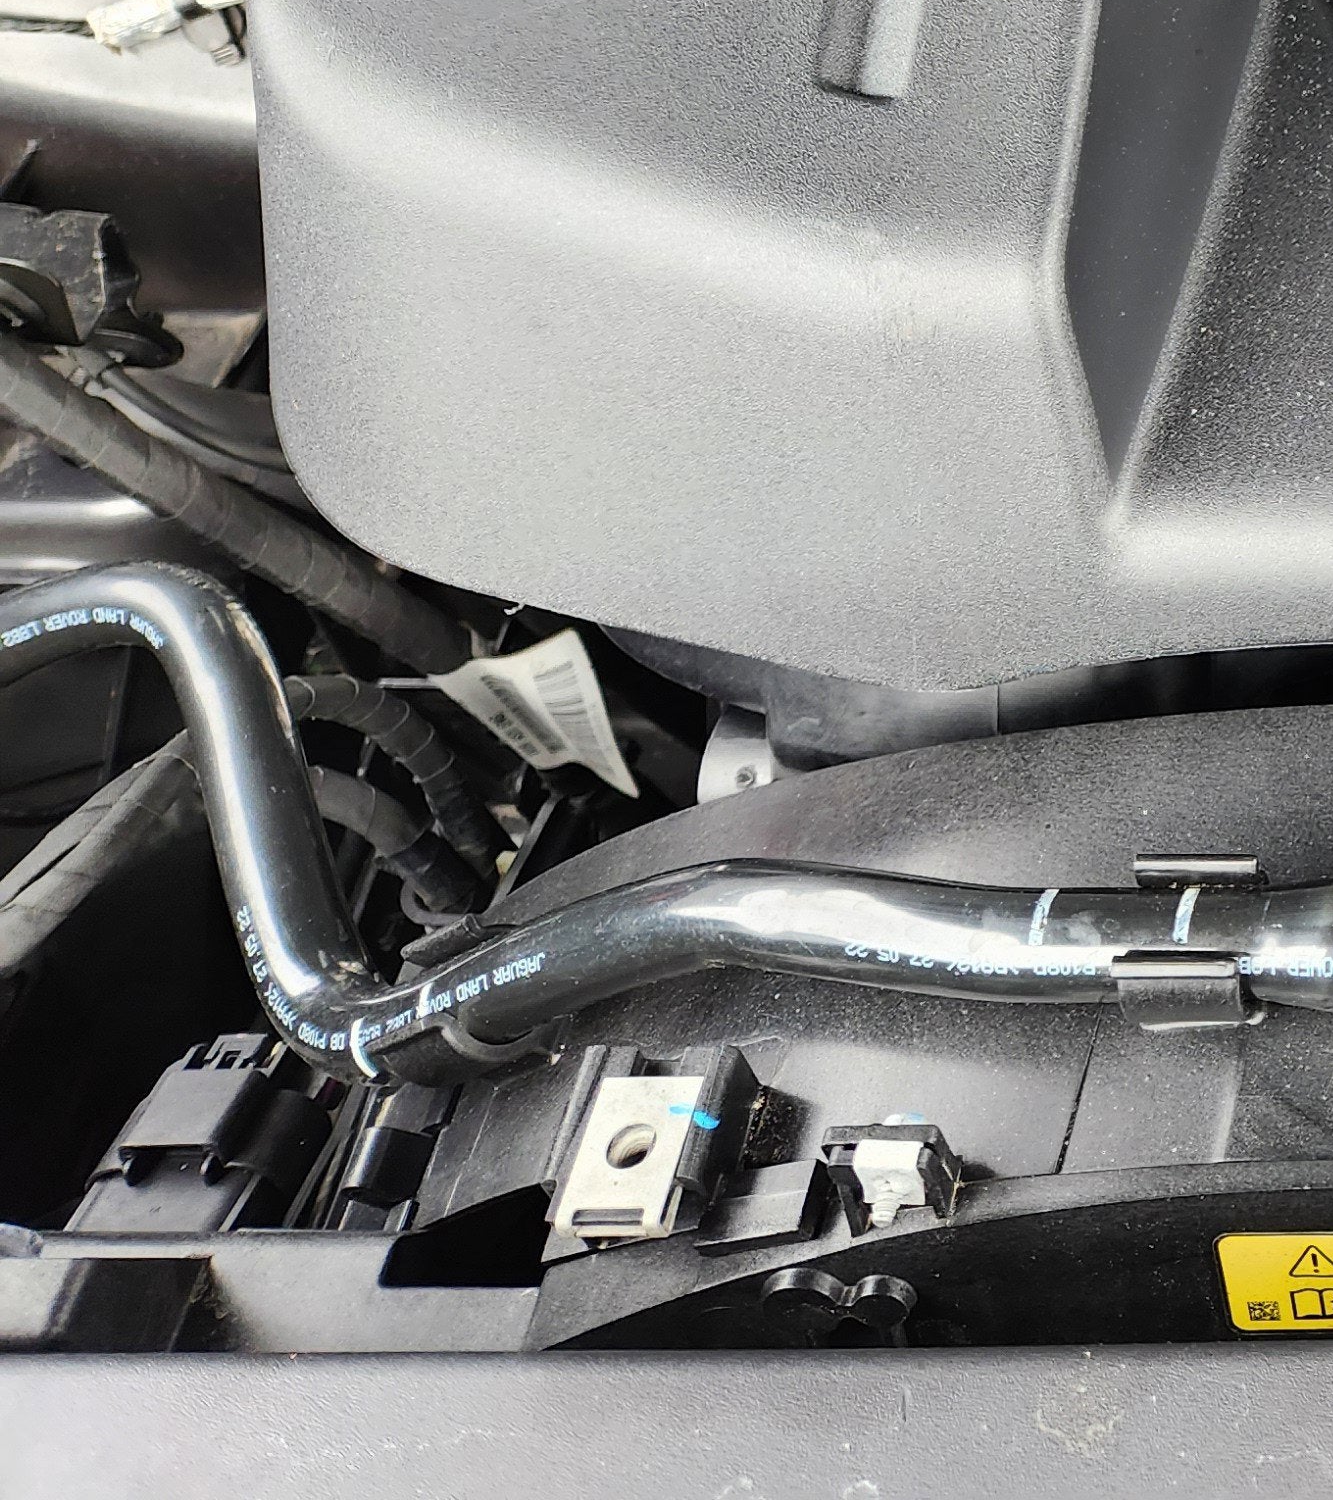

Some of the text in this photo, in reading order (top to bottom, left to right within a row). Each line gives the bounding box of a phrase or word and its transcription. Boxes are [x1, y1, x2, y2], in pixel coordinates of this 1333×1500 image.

[43, 609, 89, 633] ROVER
[92, 607, 126, 626] LAND
[493, 951, 546, 986] JAGUAR
[455, 973, 489, 1003] LAND
